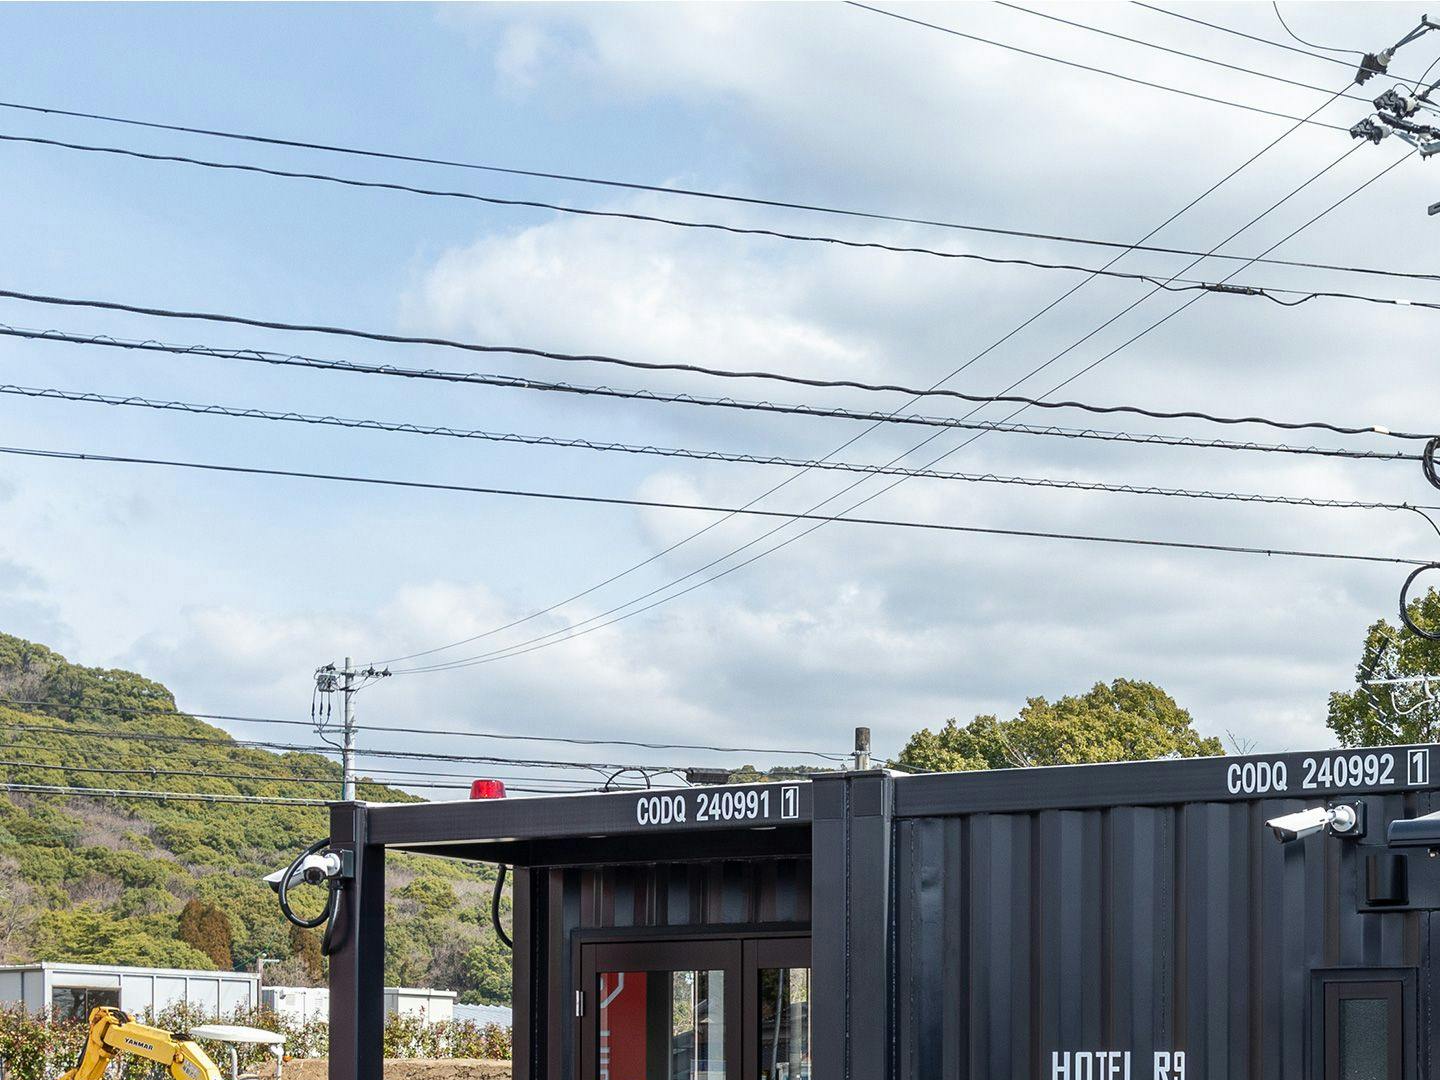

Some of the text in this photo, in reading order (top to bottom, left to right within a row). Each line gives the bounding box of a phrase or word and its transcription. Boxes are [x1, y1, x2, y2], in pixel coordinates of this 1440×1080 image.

[1227, 751, 1426, 795] CODQ 240992 1
[636, 788, 796, 825] CODQ 240991 1
[124, 1036, 154, 1051] YANMAR
